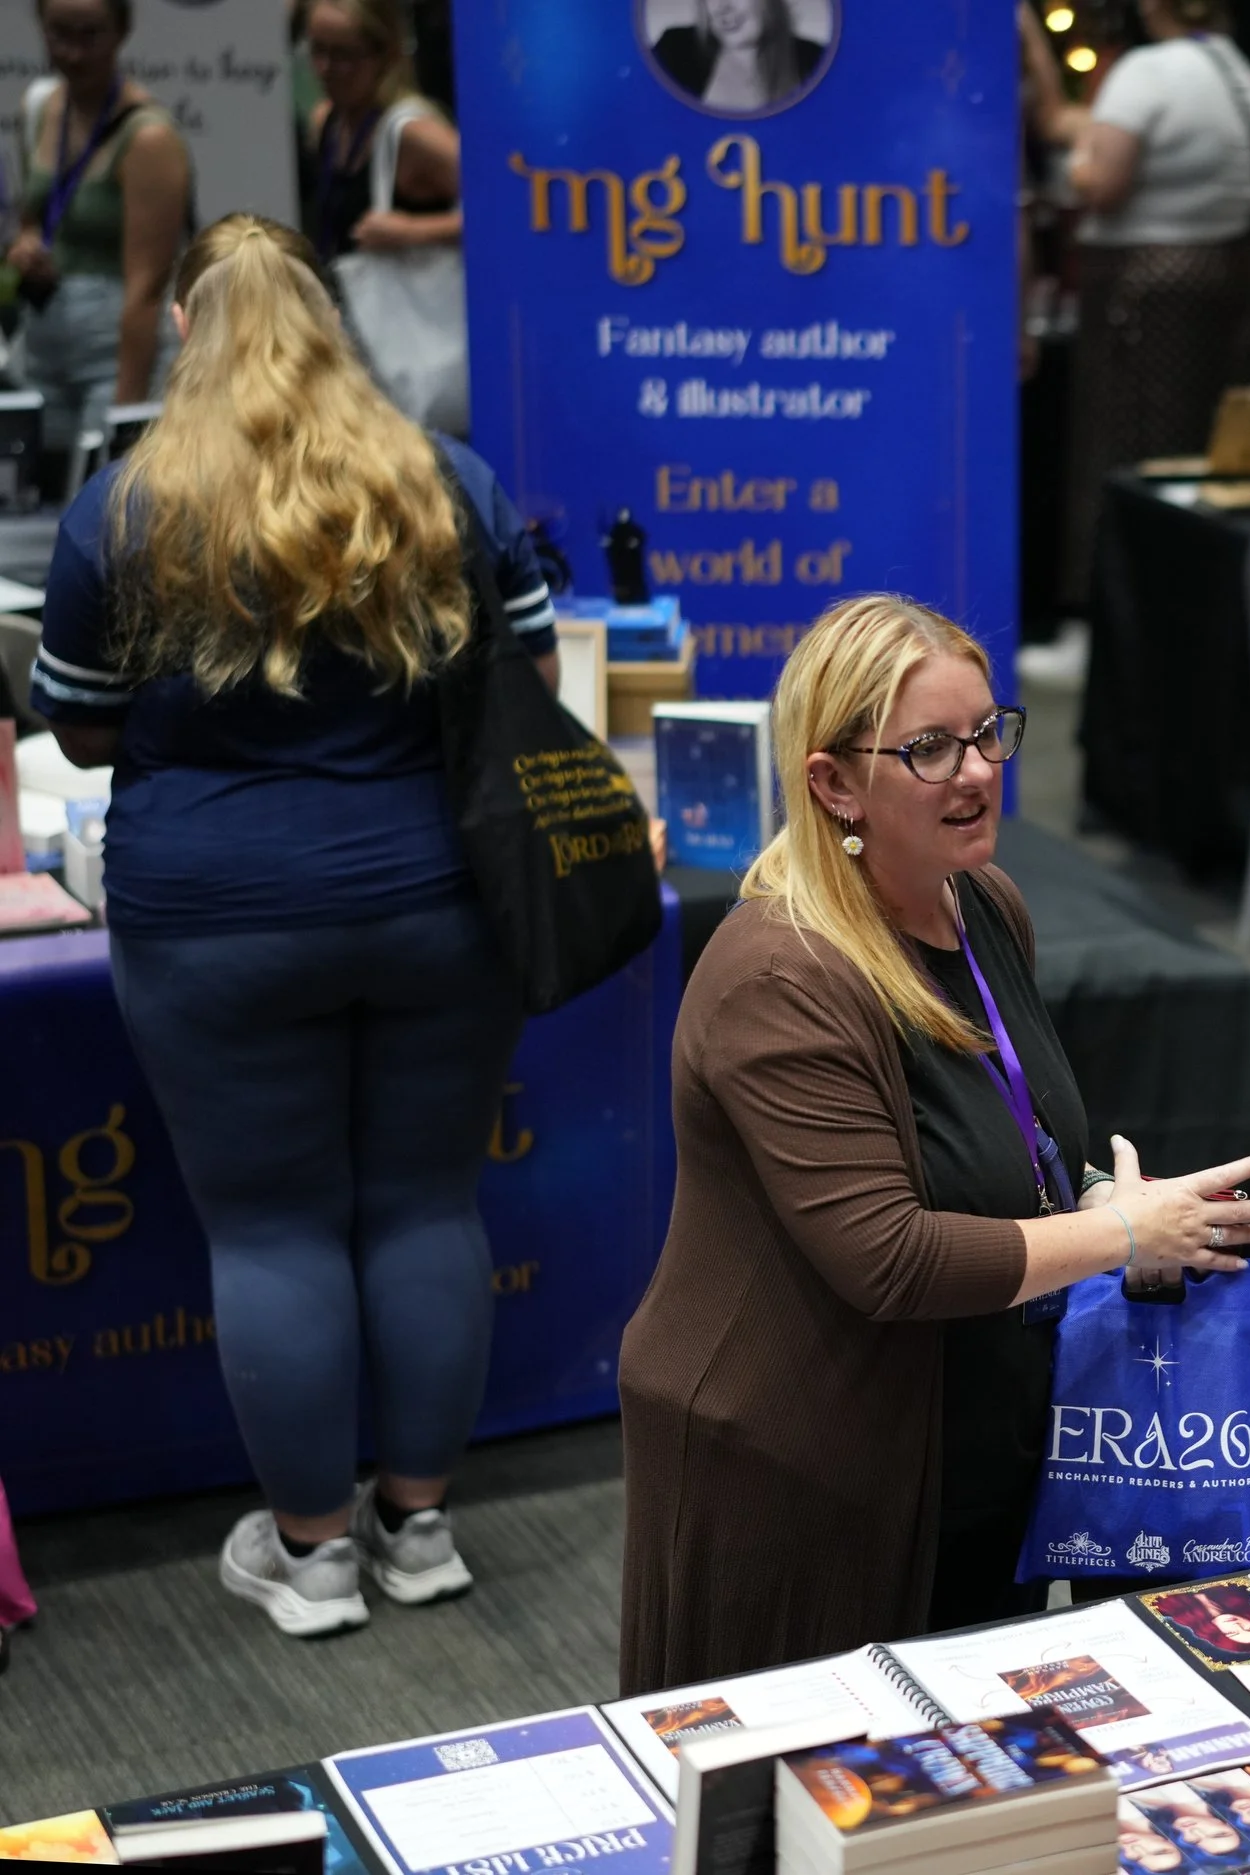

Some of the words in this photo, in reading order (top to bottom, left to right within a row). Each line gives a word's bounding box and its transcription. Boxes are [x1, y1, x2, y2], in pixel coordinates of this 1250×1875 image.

[508, 151, 686, 286] mg
[707, 133, 969, 274] hunt
[597, 316, 751, 365] Fantasy
[760, 320, 895, 359] author
[639, 377, 668, 418] &
[678, 378, 871, 419] illustrator
[656, 464, 796, 511] Enter
[810, 478, 839, 511] a
[650, 540, 781, 584] world
[795, 541, 852, 584] of
[548, 832, 610, 879] LORD
[93, 1306, 216, 1358] auth
[1048, 1471, 1124, 1485] ENCHANTED
[1129, 1477, 1184, 1489] READERS
[1189, 1479, 1196, 1488] &
[1045, 1554, 1116, 1567] TITLEPIECES
[1183, 1538, 1243, 1555] Cassandra
[1027, 1680, 1120, 1707] VAMPIRES
[1057, 1694, 1115, 1716] COVEN
[216, 1785, 275, 1806] SCARLET
[535, 1827, 648, 1865] PRICE
